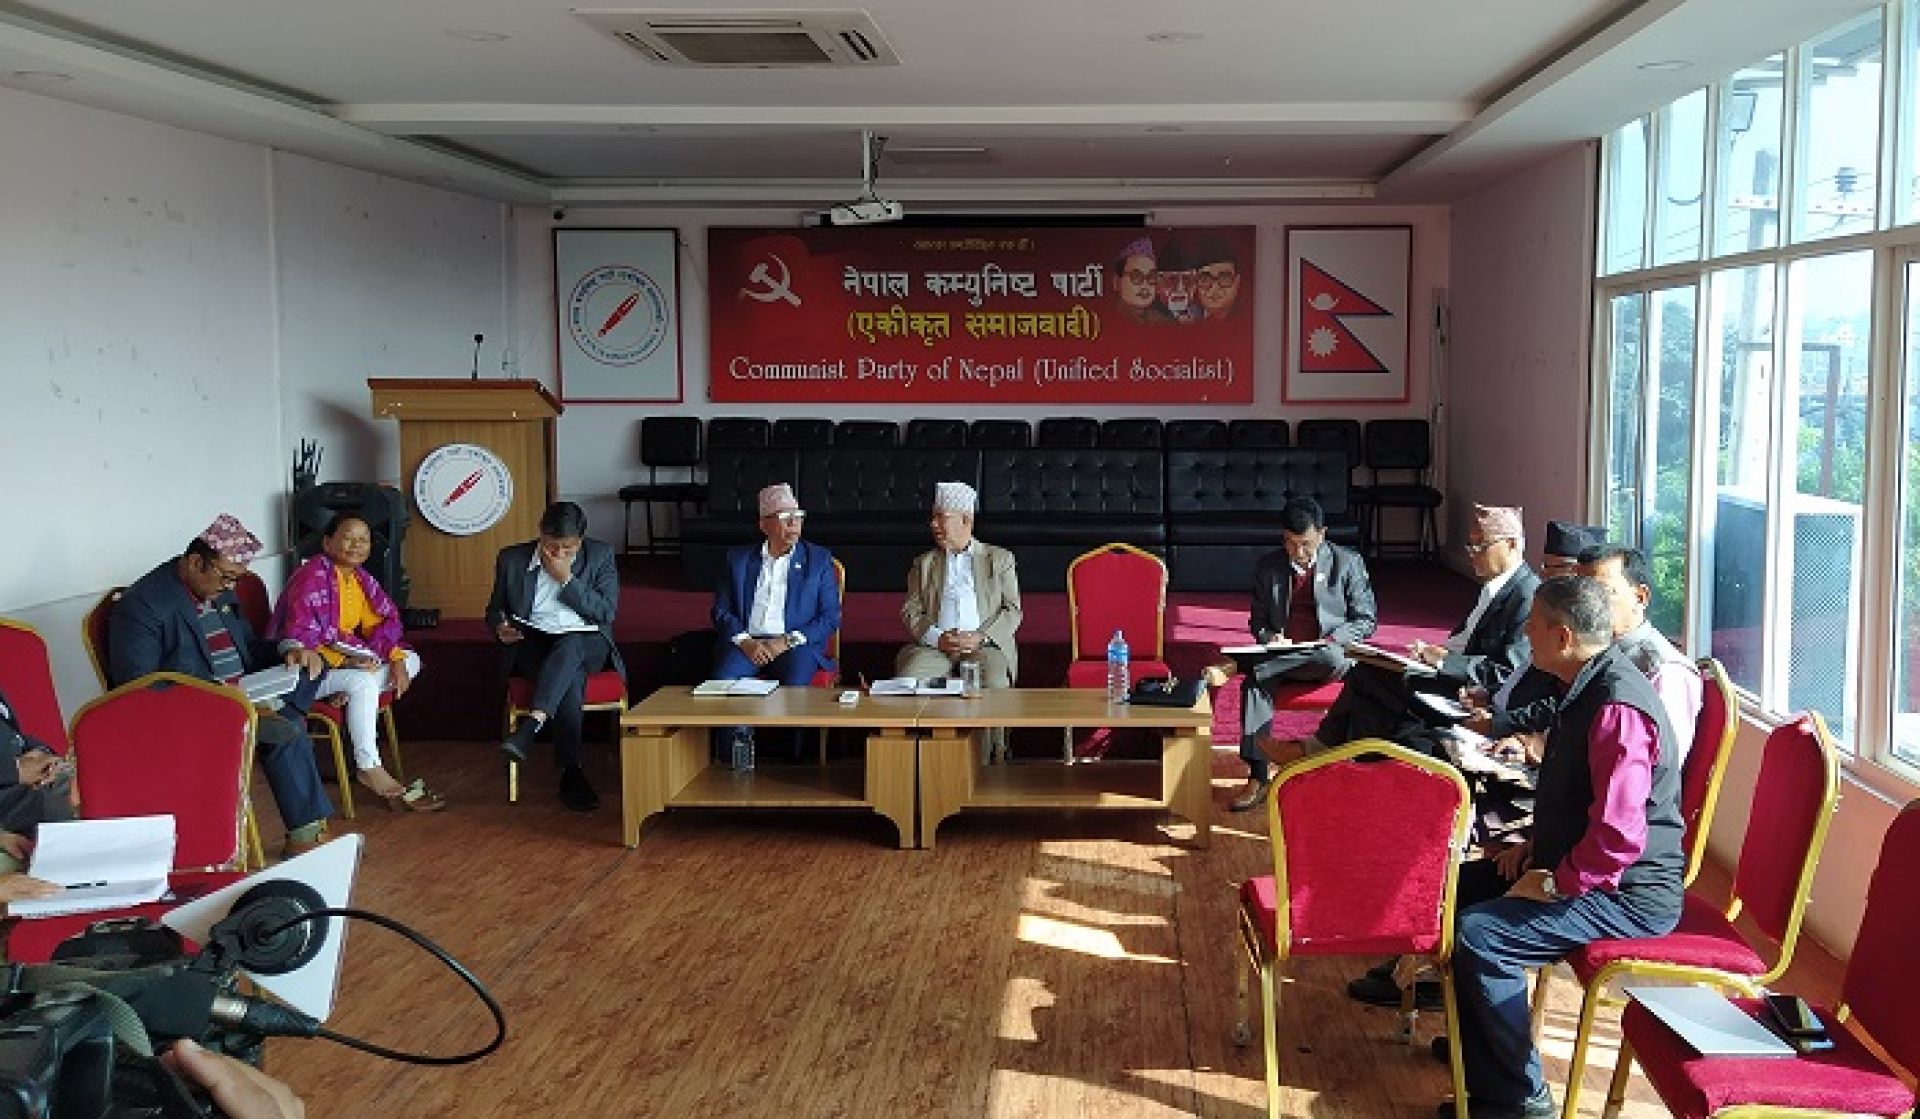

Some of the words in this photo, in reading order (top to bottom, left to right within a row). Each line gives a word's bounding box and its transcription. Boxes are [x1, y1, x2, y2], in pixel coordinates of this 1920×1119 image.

[843, 265, 909, 299] नेपाल
[1050, 263, 1104, 297] पार्टी
[847, 304, 950, 346] (एकीकृत
[730, 355, 848, 380] Communist
[857, 355, 919, 388] Party
[927, 355, 952, 380] of
[959, 355, 1023, 387] Nepal
[1034, 355, 1120, 387] (Unified
[1129, 355, 1232, 387] Socialist)
